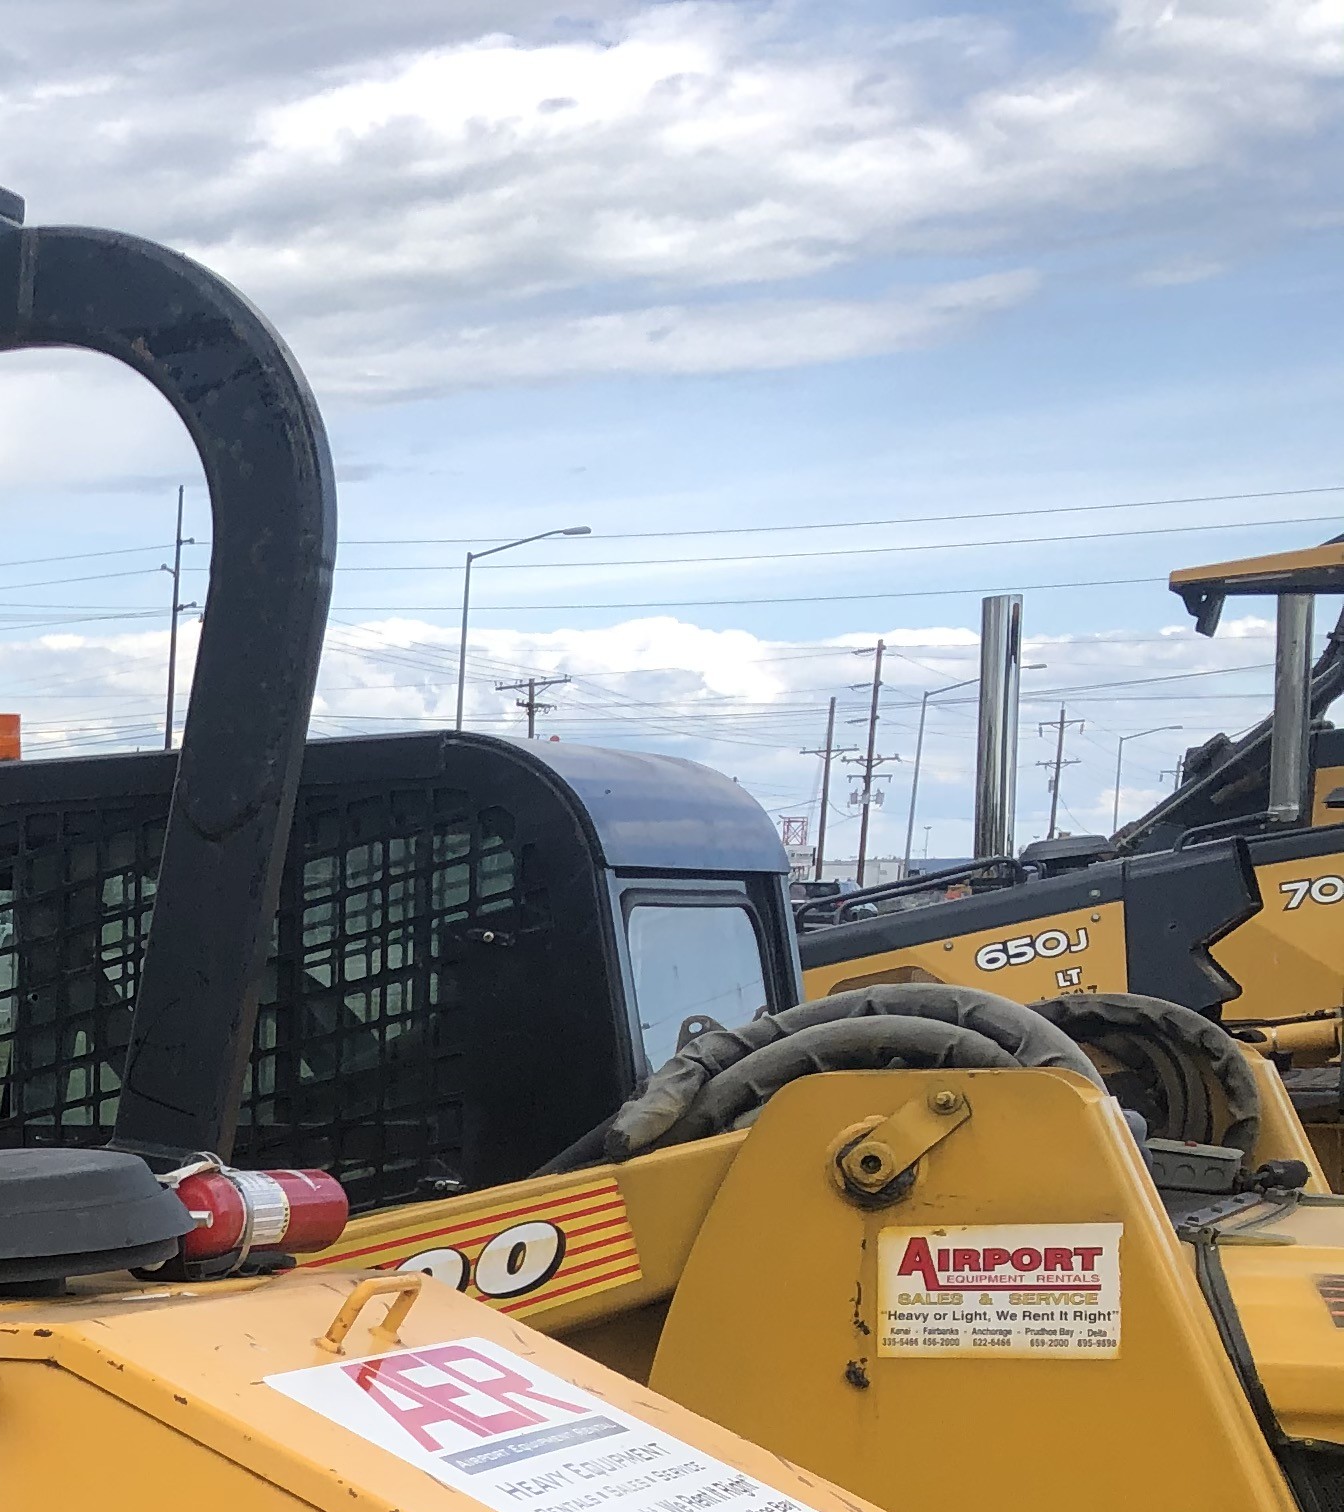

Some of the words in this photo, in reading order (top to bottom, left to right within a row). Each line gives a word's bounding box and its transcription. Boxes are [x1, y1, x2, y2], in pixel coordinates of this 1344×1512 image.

[975, 927, 1089, 973] 650J
[1055, 966, 1083, 989] LT
[897, 1237, 1103, 1279] AIRPORT
[946, 1274, 1025, 1284] EQUIPMENT
[1036, 1273, 1100, 1283] RENTALS
[898, 1292, 963, 1306] SALES
[979, 1292, 993, 1306] &
[1008, 1292, 1099, 1306] SERVICE
[934, 1312, 948, 1321] or
[952, 1310, 991, 1323] Light,
[996, 1310, 1017, 1321] We
[1022, 1310, 1055, 1321] Rent
[1059, 1310, 1069, 1321] It
[923, 1326, 959, 1335] Fairbanks
[971, 1327, 1013, 1337] Anchorage
[1059, 1327, 1074, 1338] Bay
[341, 1346, 591, 1452] AER
[495, 1470, 574, 1501] HEAVY
[562, 1442, 671, 1480] EQUIPMENT
[602, 1478, 647, 1498] SALES
[651, 1461, 707, 1482] SERVICE
